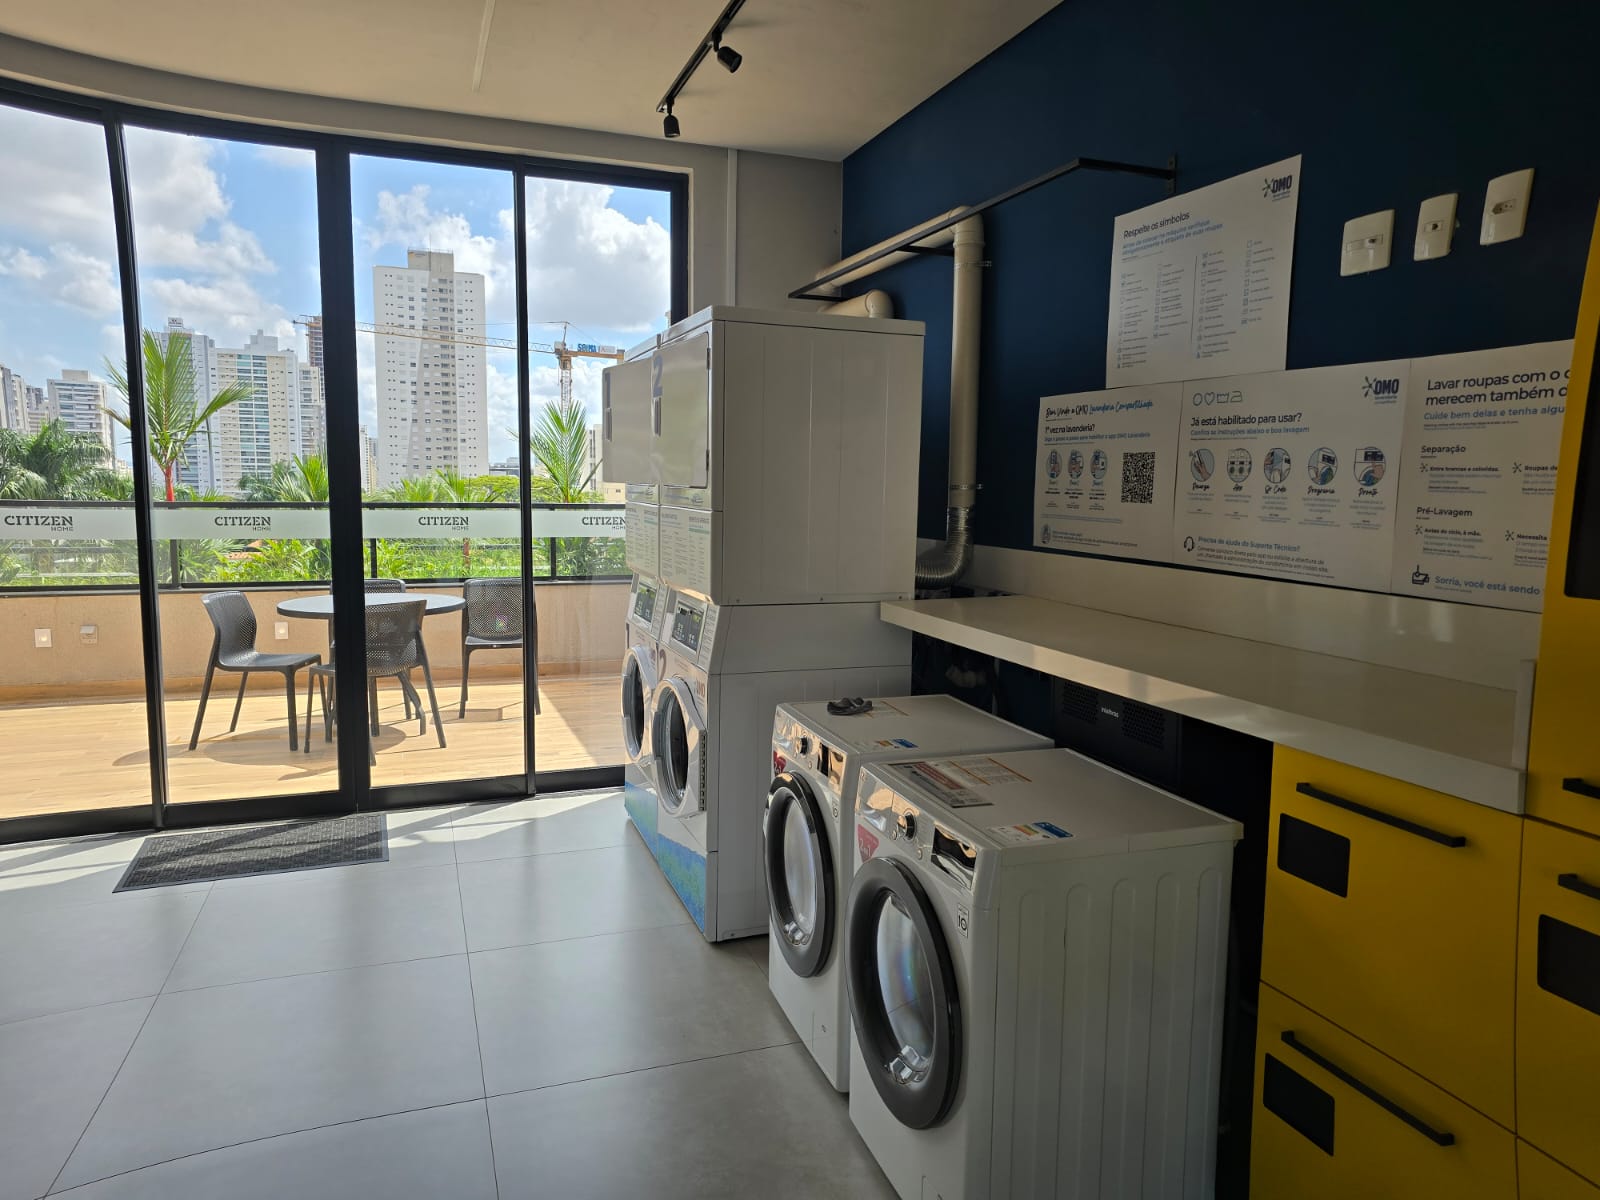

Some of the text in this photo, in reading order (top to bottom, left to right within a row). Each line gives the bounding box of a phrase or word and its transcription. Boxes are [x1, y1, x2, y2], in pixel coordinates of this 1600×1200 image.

[1272, 175, 1292, 193] OMO
[1124, 212, 1190, 239] Respeite os símbolos
[653, 354, 663, 397] 2
[1428, 379, 1460, 390] Lavar
[1463, 375, 1509, 388] roupas
[1512, 371, 1545, 384] com
[1550, 370, 1560, 380] o
[1374, 379, 1399, 394] OMO
[1426, 392, 1486, 405] merecem
[1490, 386, 1554, 402] também
[1190, 412, 1302, 426] Já está habilitado para usar?
[1450, 410, 1471, 419] bem
[1472, 409, 1497, 418] delas
[1508, 407, 1538, 416] tenha
[1066, 424, 1095, 433] lavanderia?
[1421, 444, 1466, 455] Separação
[1416, 506, 1473, 518] Pré-Lavagem
[4, 516, 72, 525] CITIZEN
[215, 516, 271, 526] CITIZEN
[418, 517, 469, 525] CITIZEN
[582, 517, 626, 525] CITIZEN
[1435, 575, 1541, 595] Sorria, você está sendo
